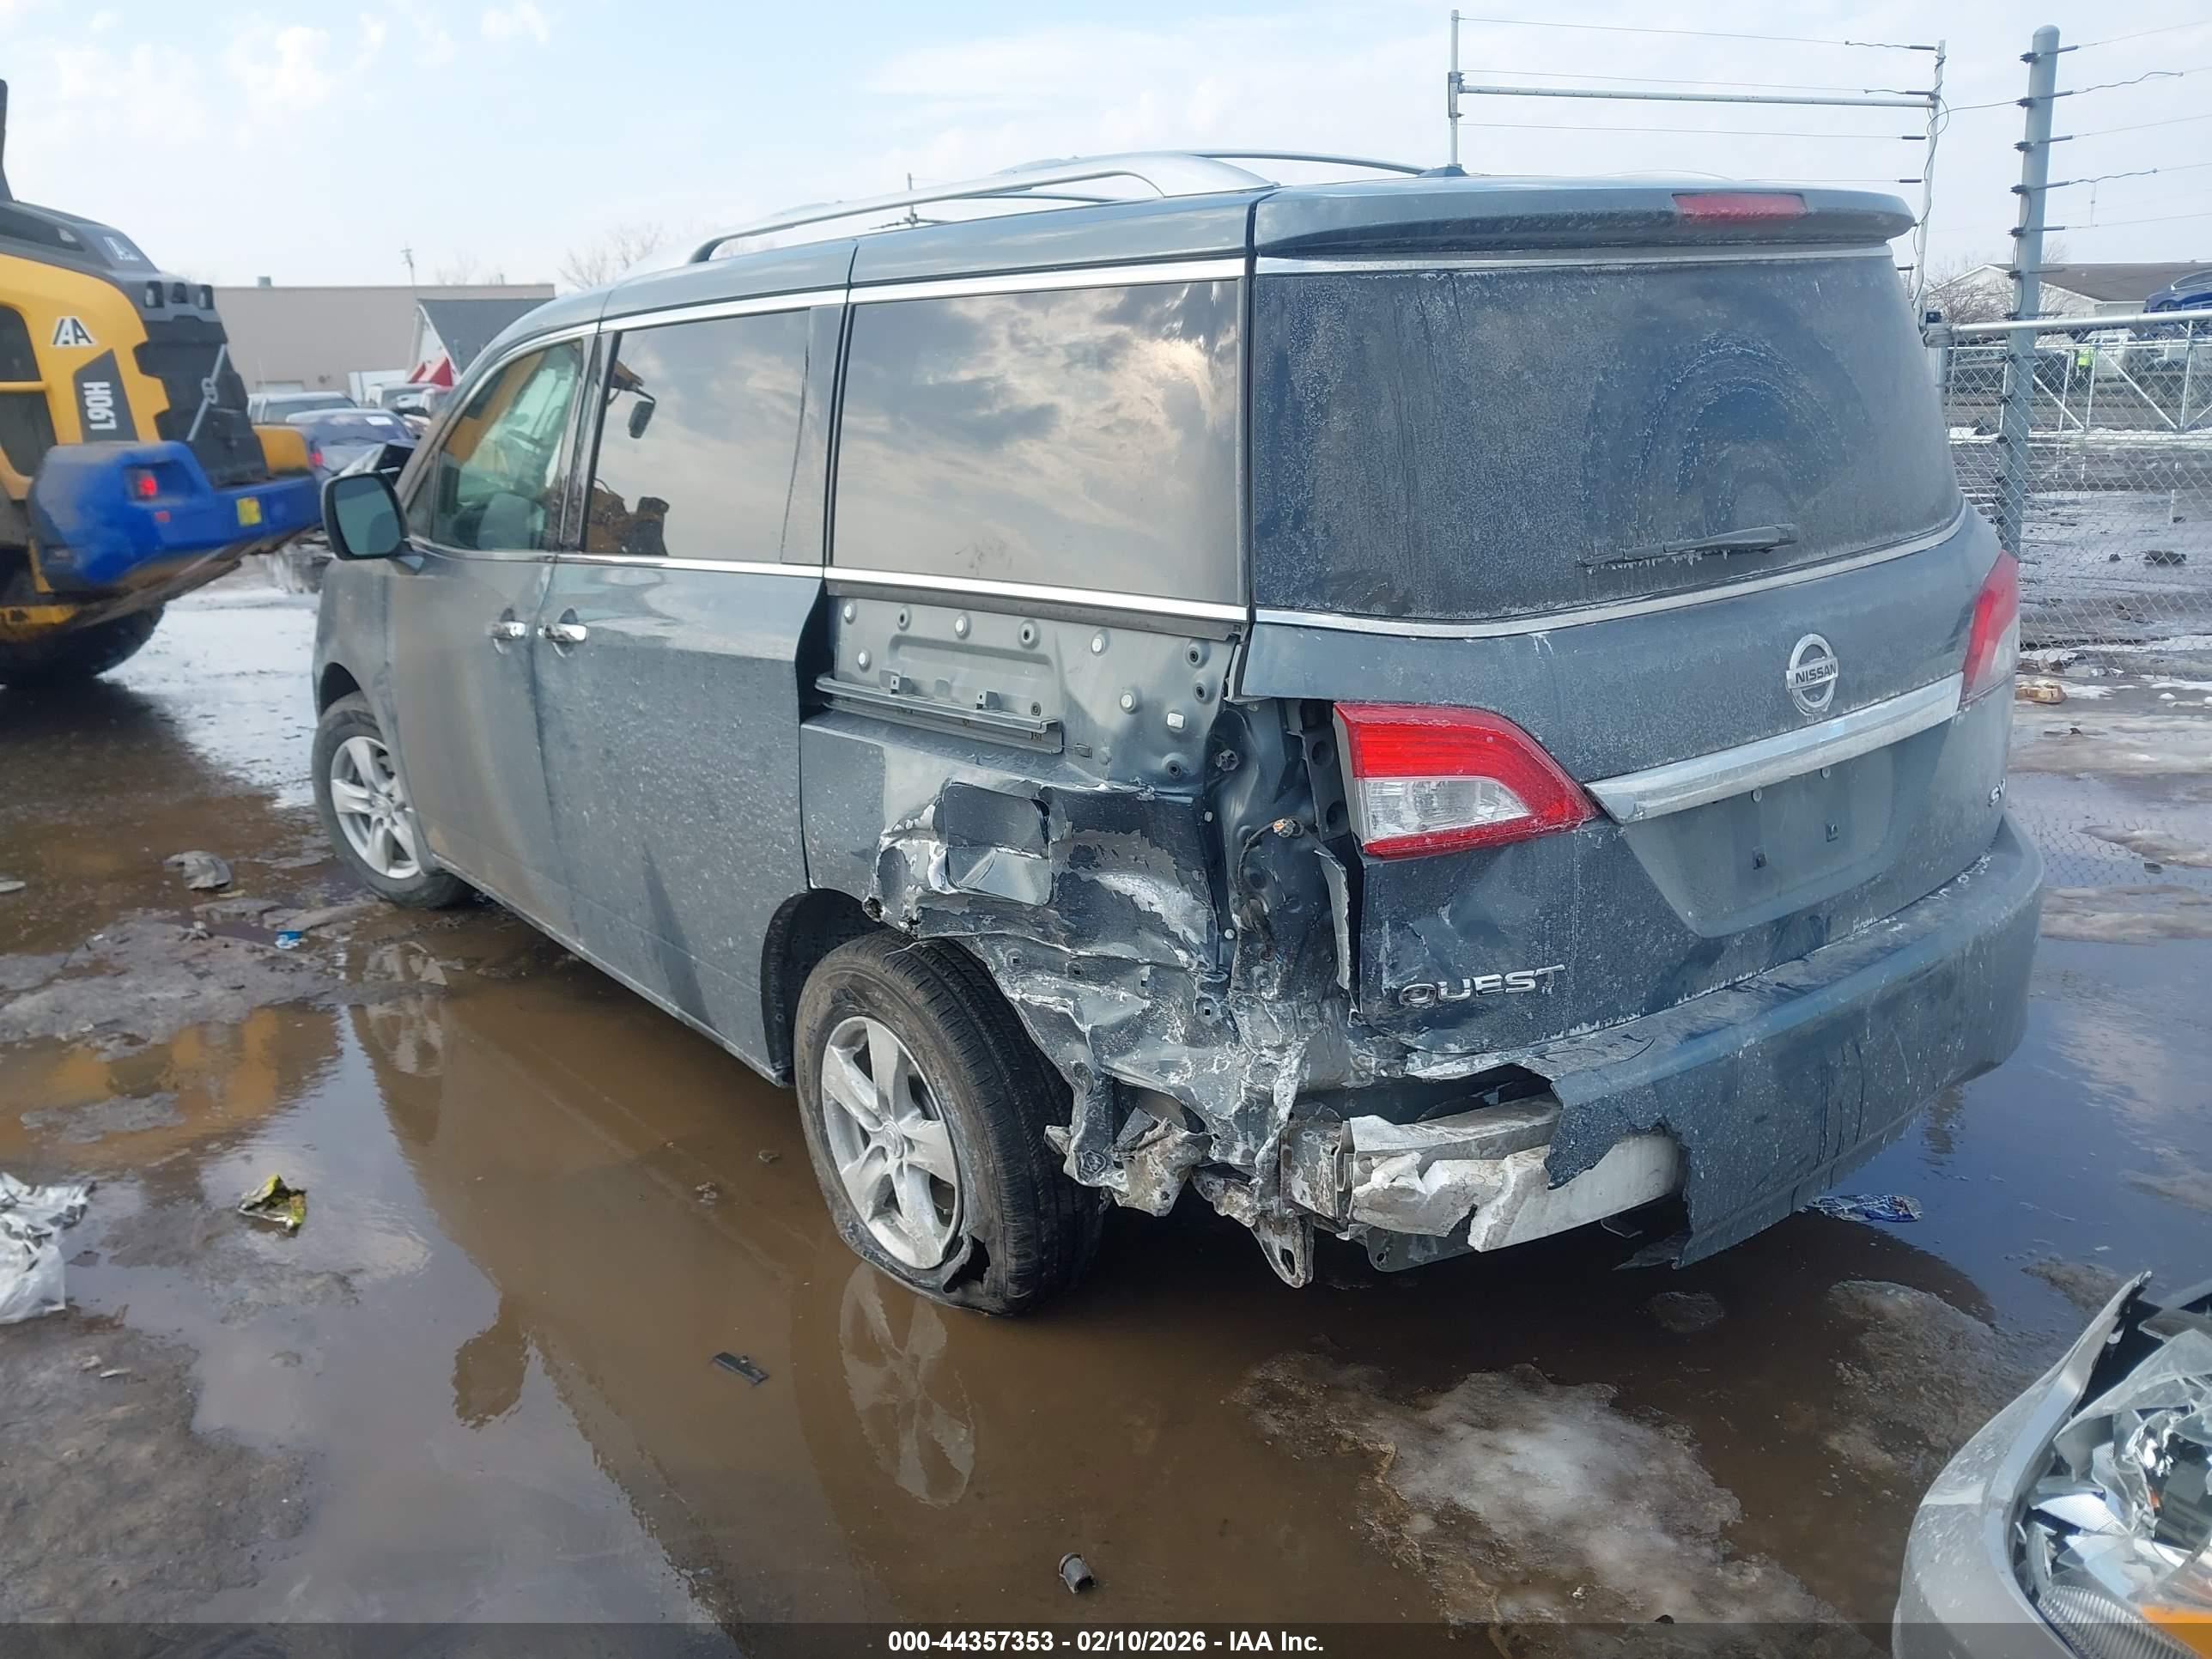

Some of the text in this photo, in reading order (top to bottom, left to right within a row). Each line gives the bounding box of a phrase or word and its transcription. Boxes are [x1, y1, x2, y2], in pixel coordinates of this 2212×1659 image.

[83, 381, 117, 430] L90H
[1796, 664, 1837, 684] NISSAN
[1399, 964, 1565, 1008] QUEST
